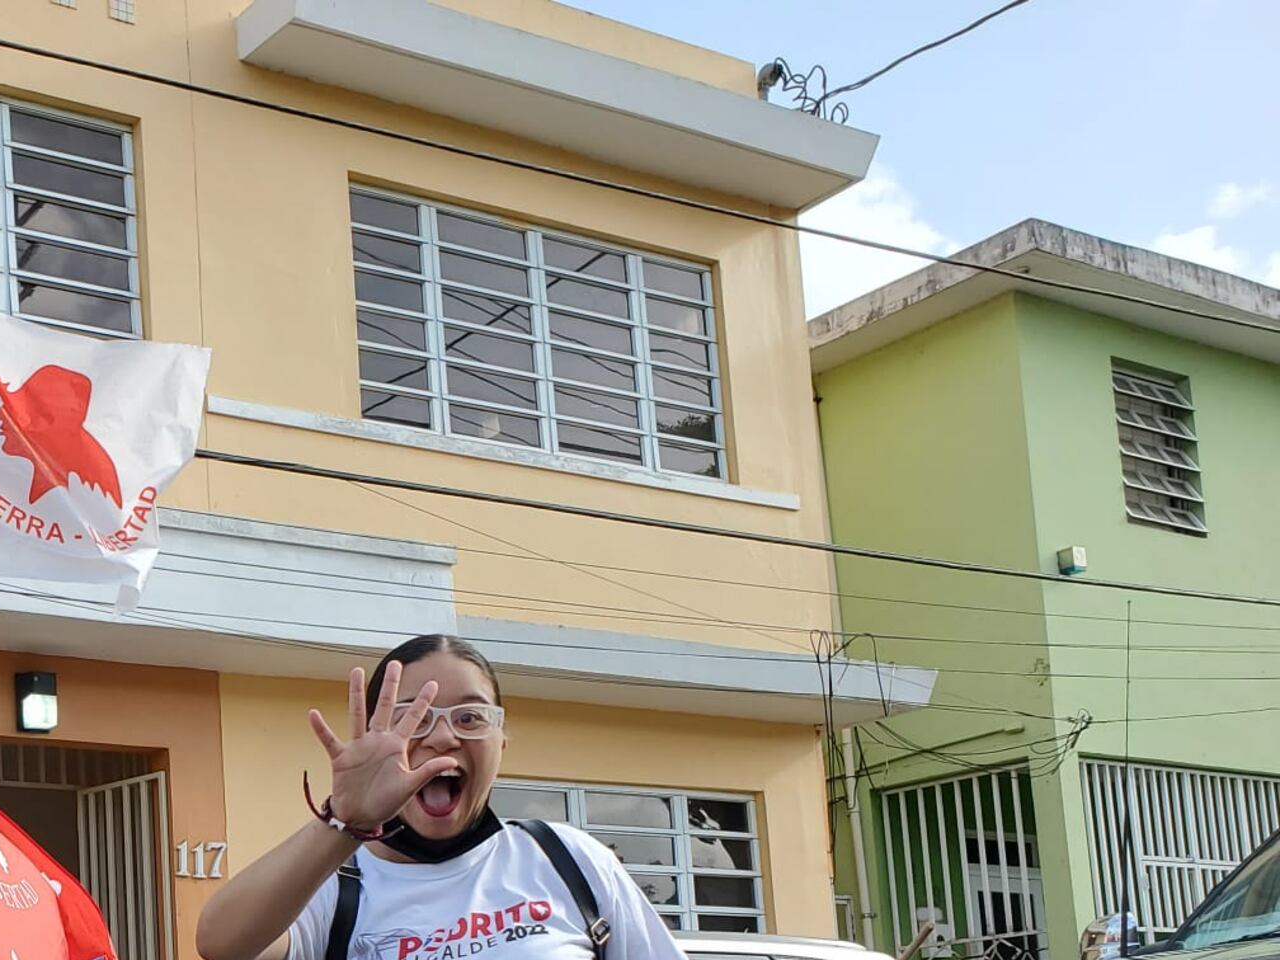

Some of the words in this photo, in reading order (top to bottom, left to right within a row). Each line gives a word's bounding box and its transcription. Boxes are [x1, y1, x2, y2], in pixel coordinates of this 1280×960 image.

[175, 840, 227, 879] 117
[398, 900, 552, 960] PEDRITO
[503, 923, 549, 943] 2022
